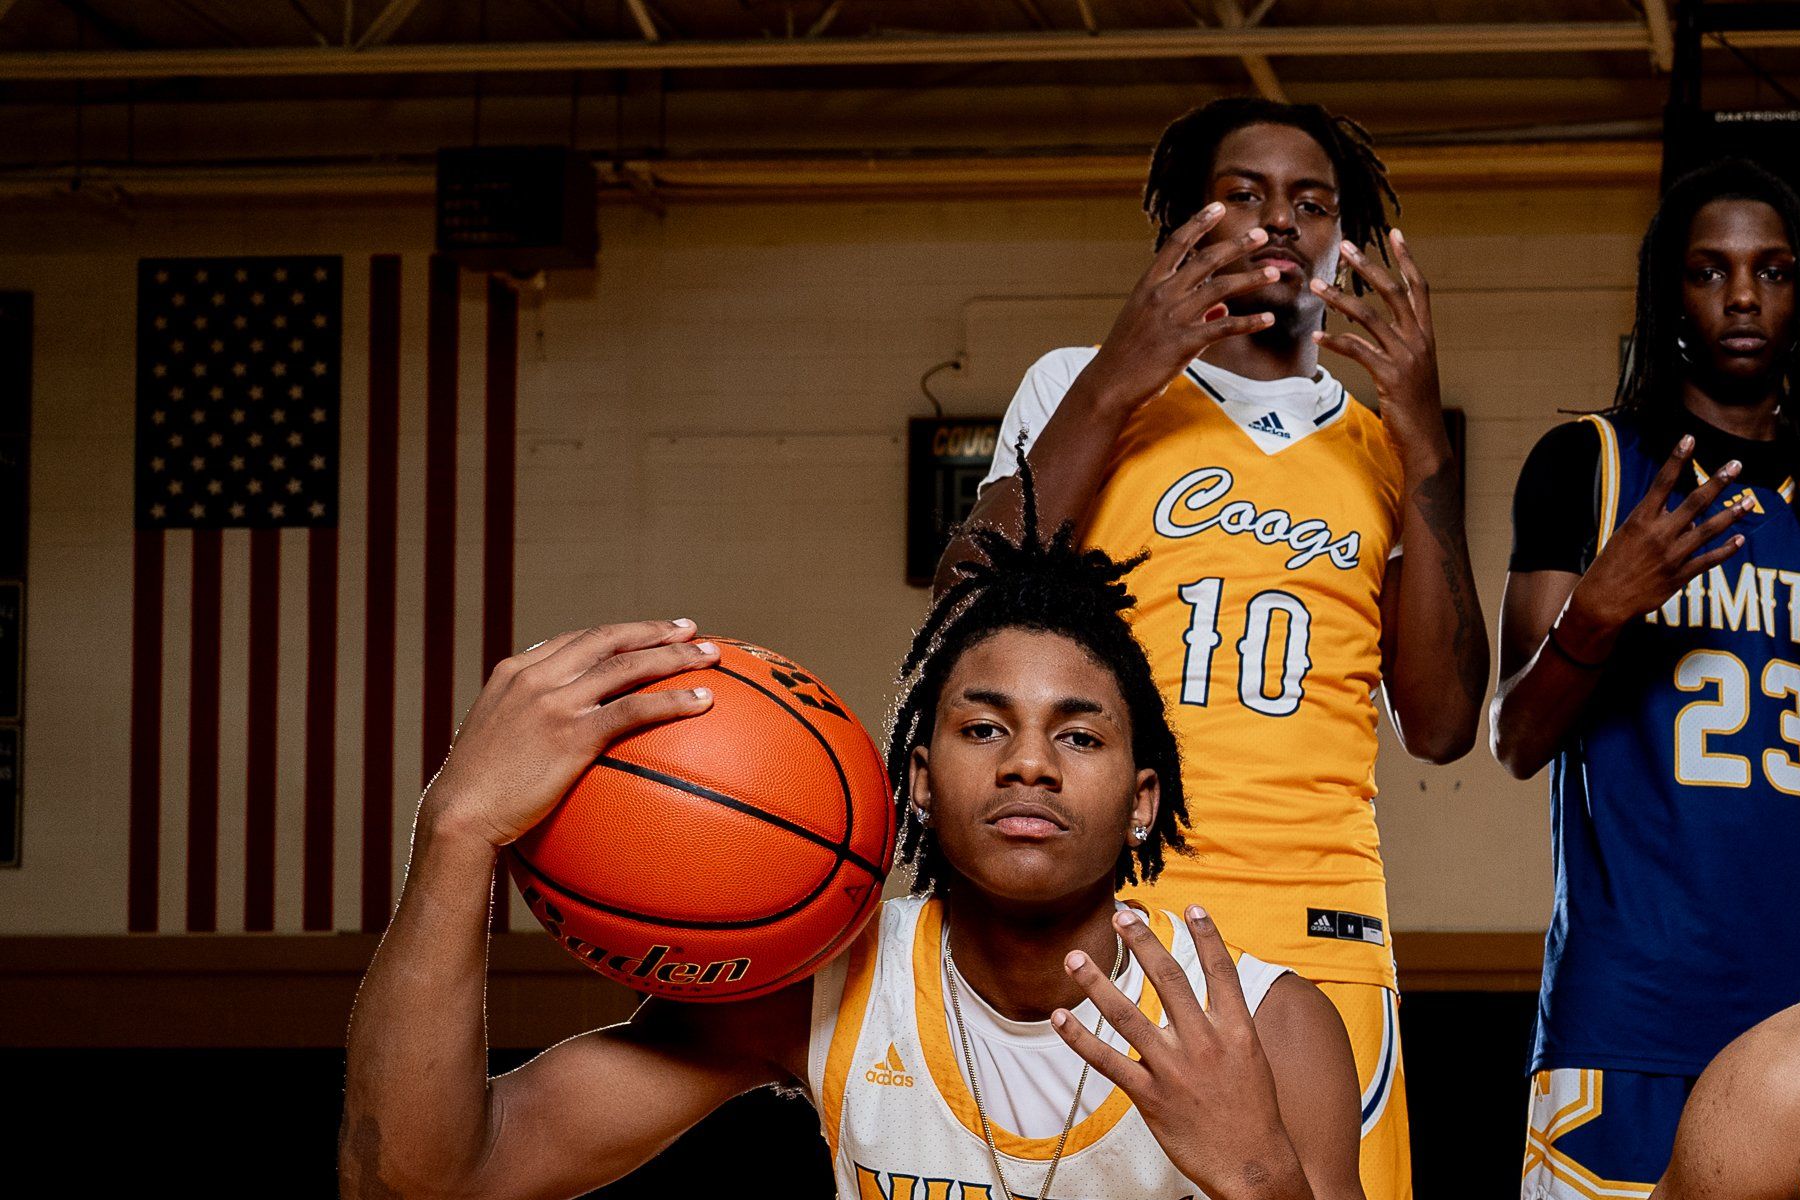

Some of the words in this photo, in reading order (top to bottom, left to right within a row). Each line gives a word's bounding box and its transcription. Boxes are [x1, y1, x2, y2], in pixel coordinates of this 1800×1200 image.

[1248, 422, 1290, 439] adidas
[1153, 466, 1360, 569] Coogs
[1178, 577, 1312, 717] 10
[1310, 924, 1334, 933] adidas
